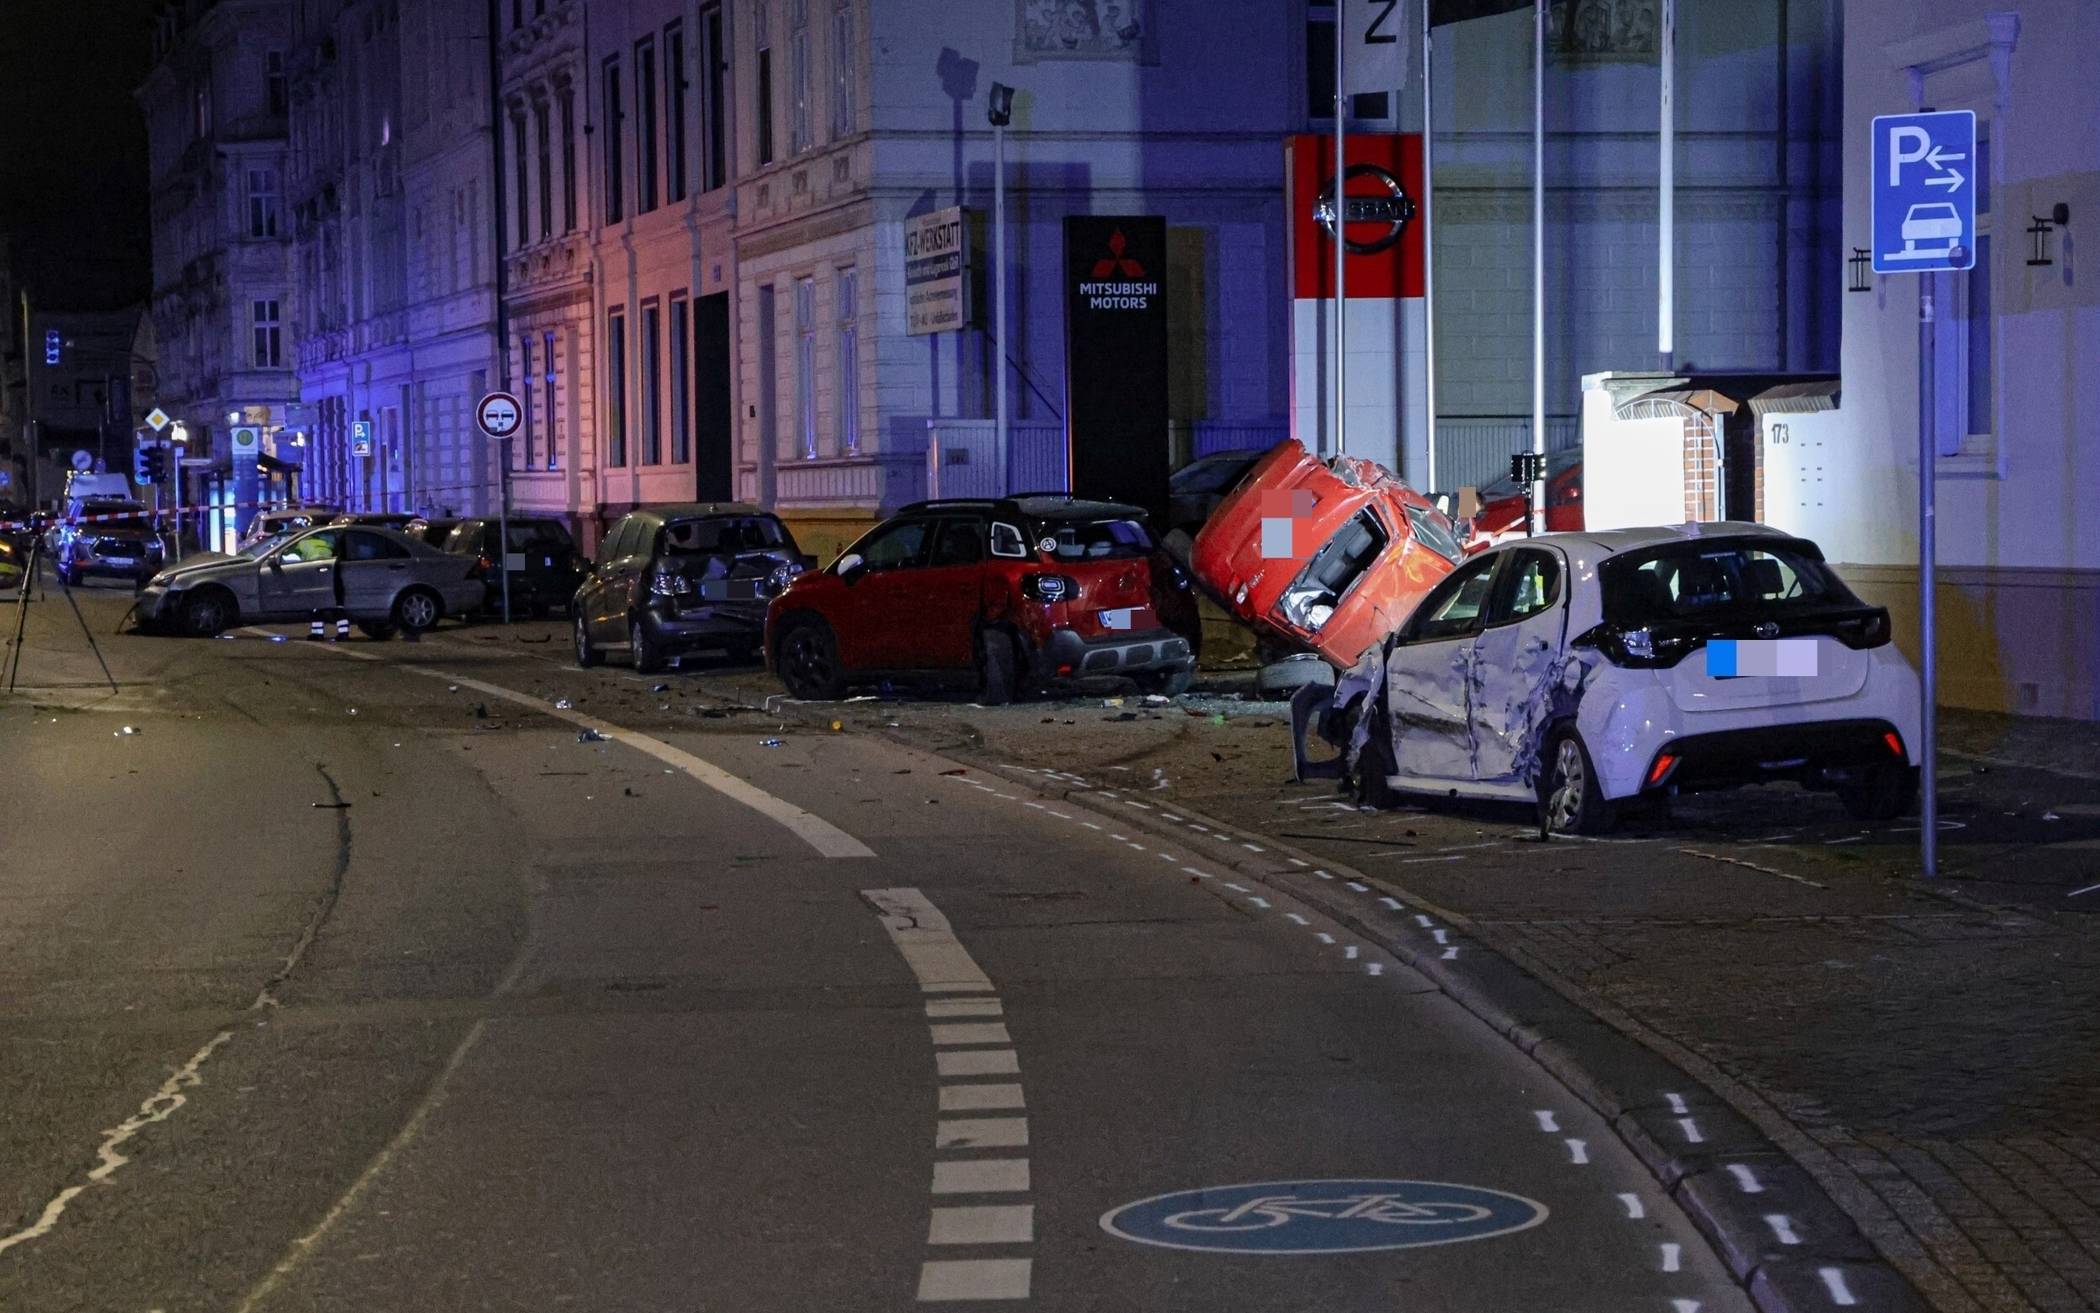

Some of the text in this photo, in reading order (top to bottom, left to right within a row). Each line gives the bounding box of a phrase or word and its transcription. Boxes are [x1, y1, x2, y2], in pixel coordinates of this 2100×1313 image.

[1890, 126, 1931, 187] P
[1080, 283, 1157, 295] MITSUBISHI
[1090, 297, 1147, 309] MOTORS
[355, 423, 364, 438] P
[1771, 423, 1789, 444] 173
